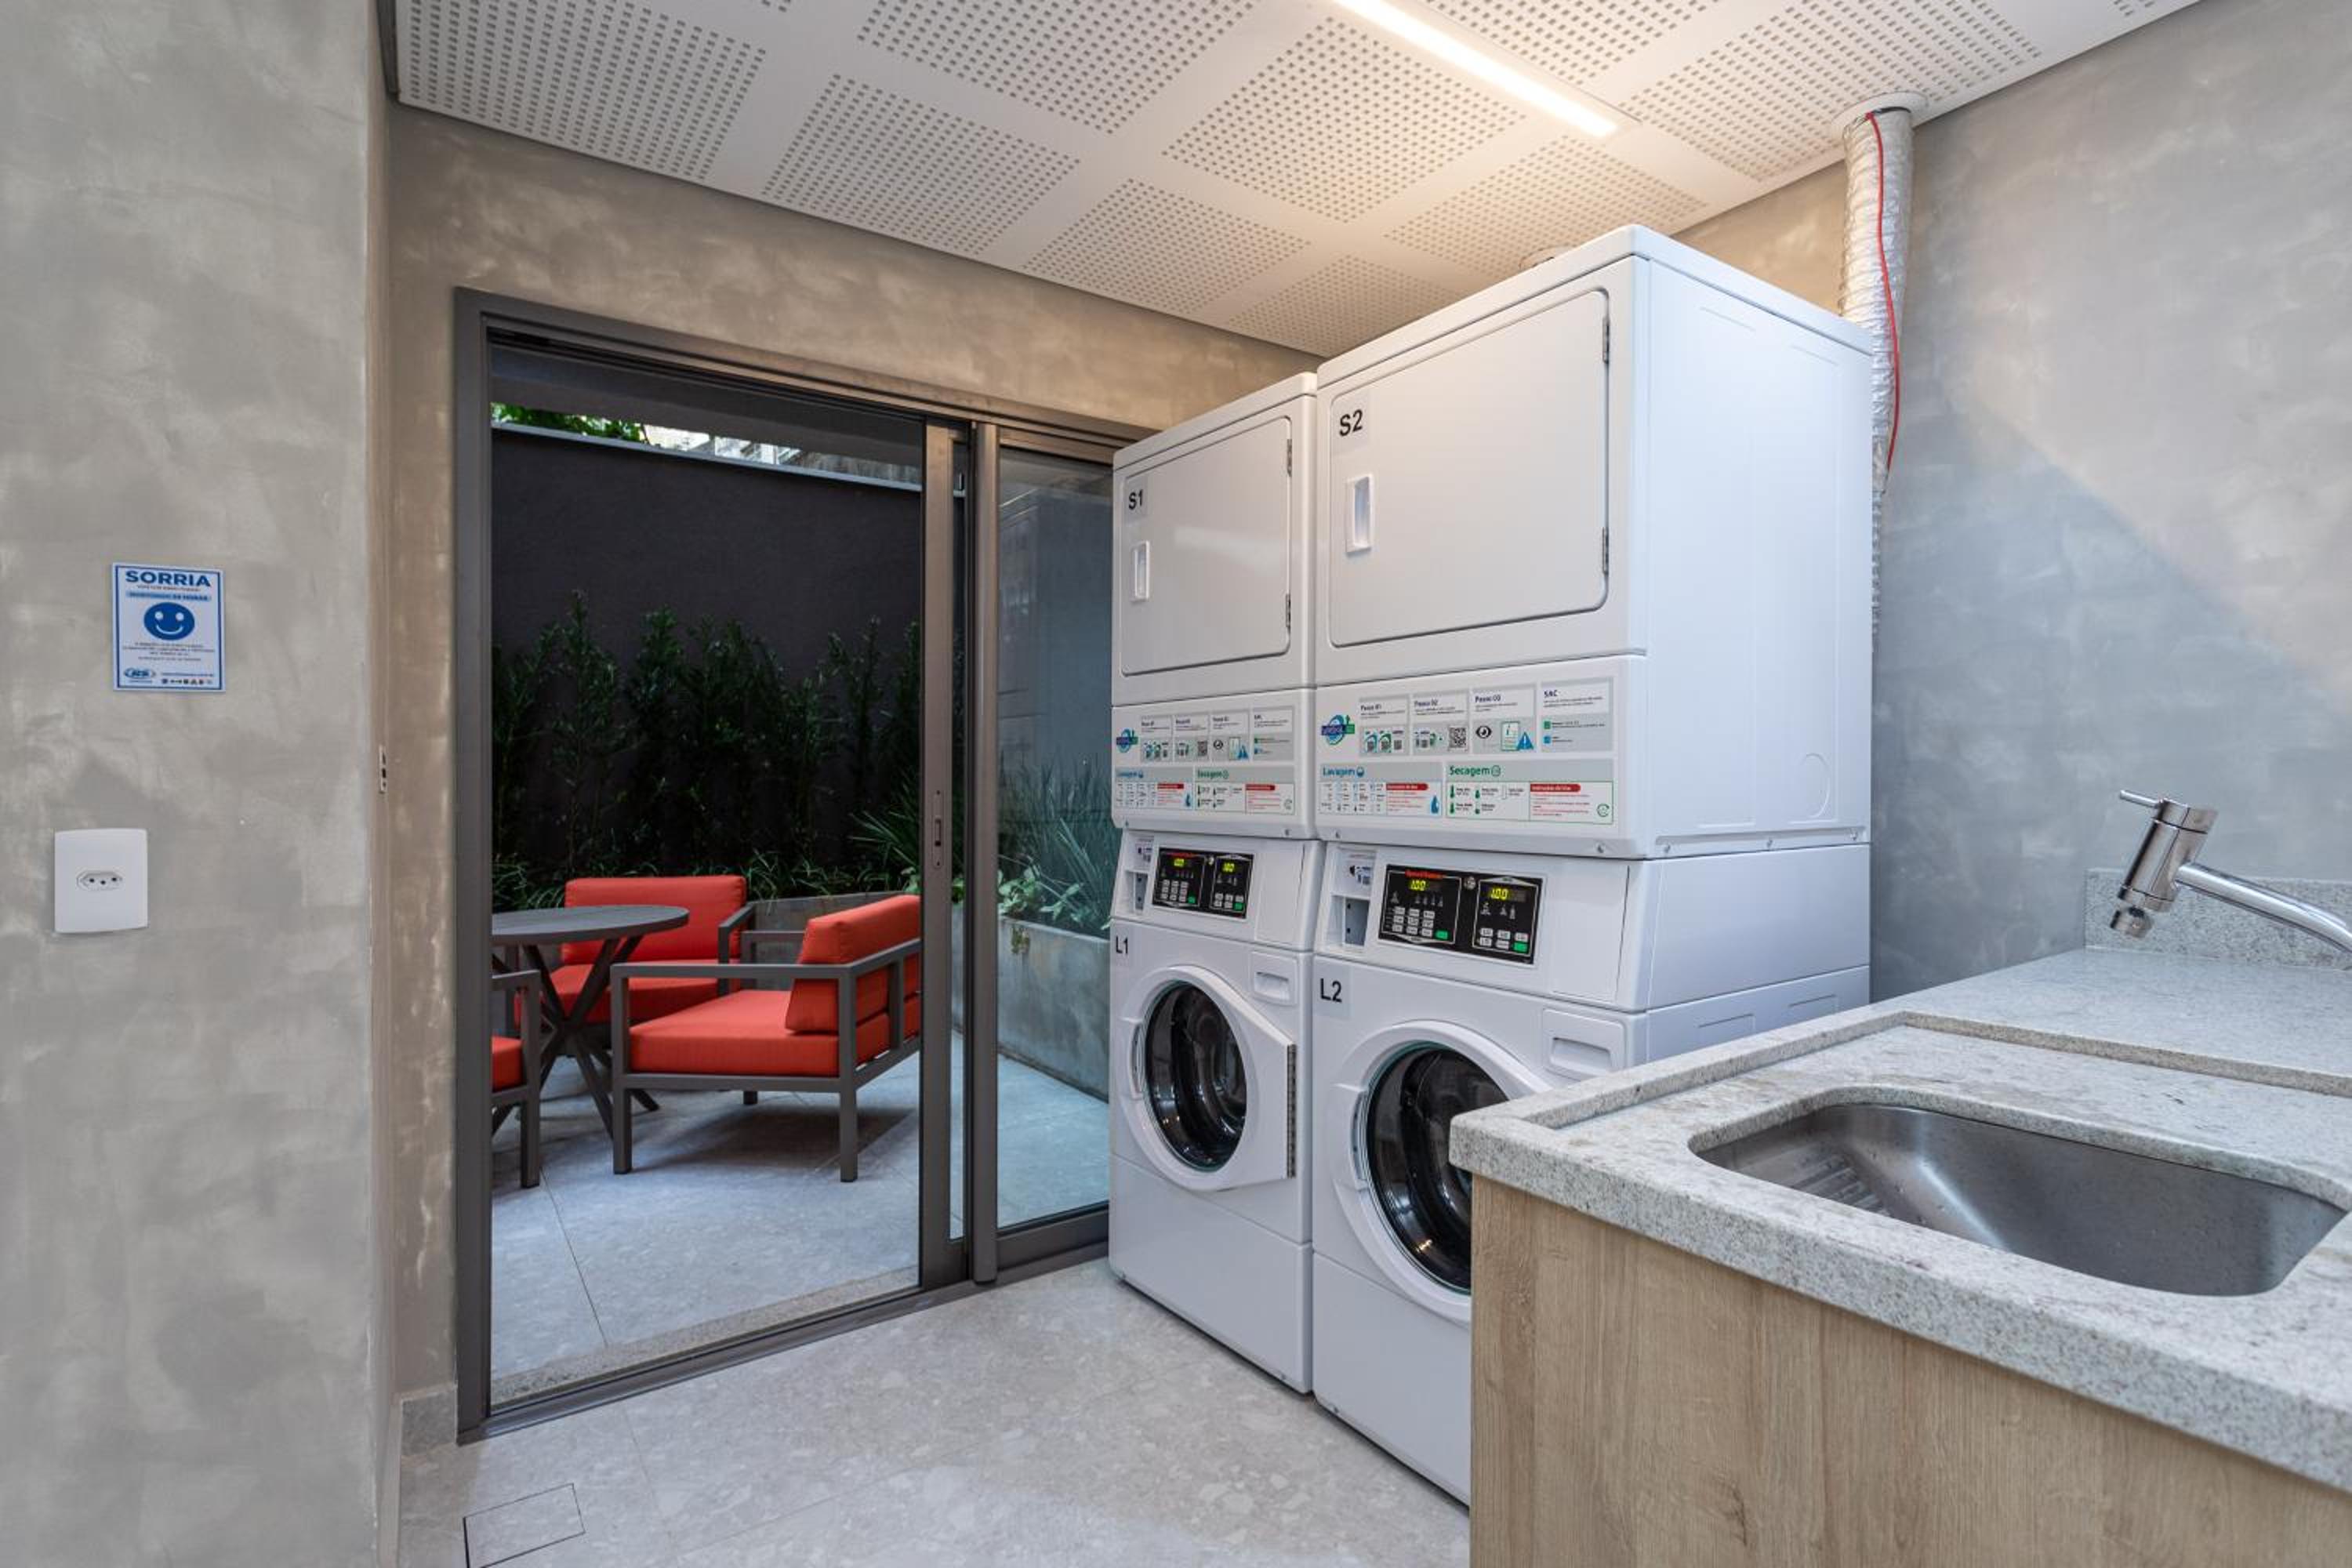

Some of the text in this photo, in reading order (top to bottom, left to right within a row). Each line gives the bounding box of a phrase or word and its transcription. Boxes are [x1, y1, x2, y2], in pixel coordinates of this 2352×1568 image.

[1339, 409, 1363, 437] S2
[1128, 488, 1144, 510] S1
[125, 571, 211, 587] SORRIA
[1323, 767, 1355, 779] Lavagem
[1450, 765, 1490, 777] Secagem
[1116, 935, 1128, 954] L1
[1320, 978, 1341, 1003] L2
